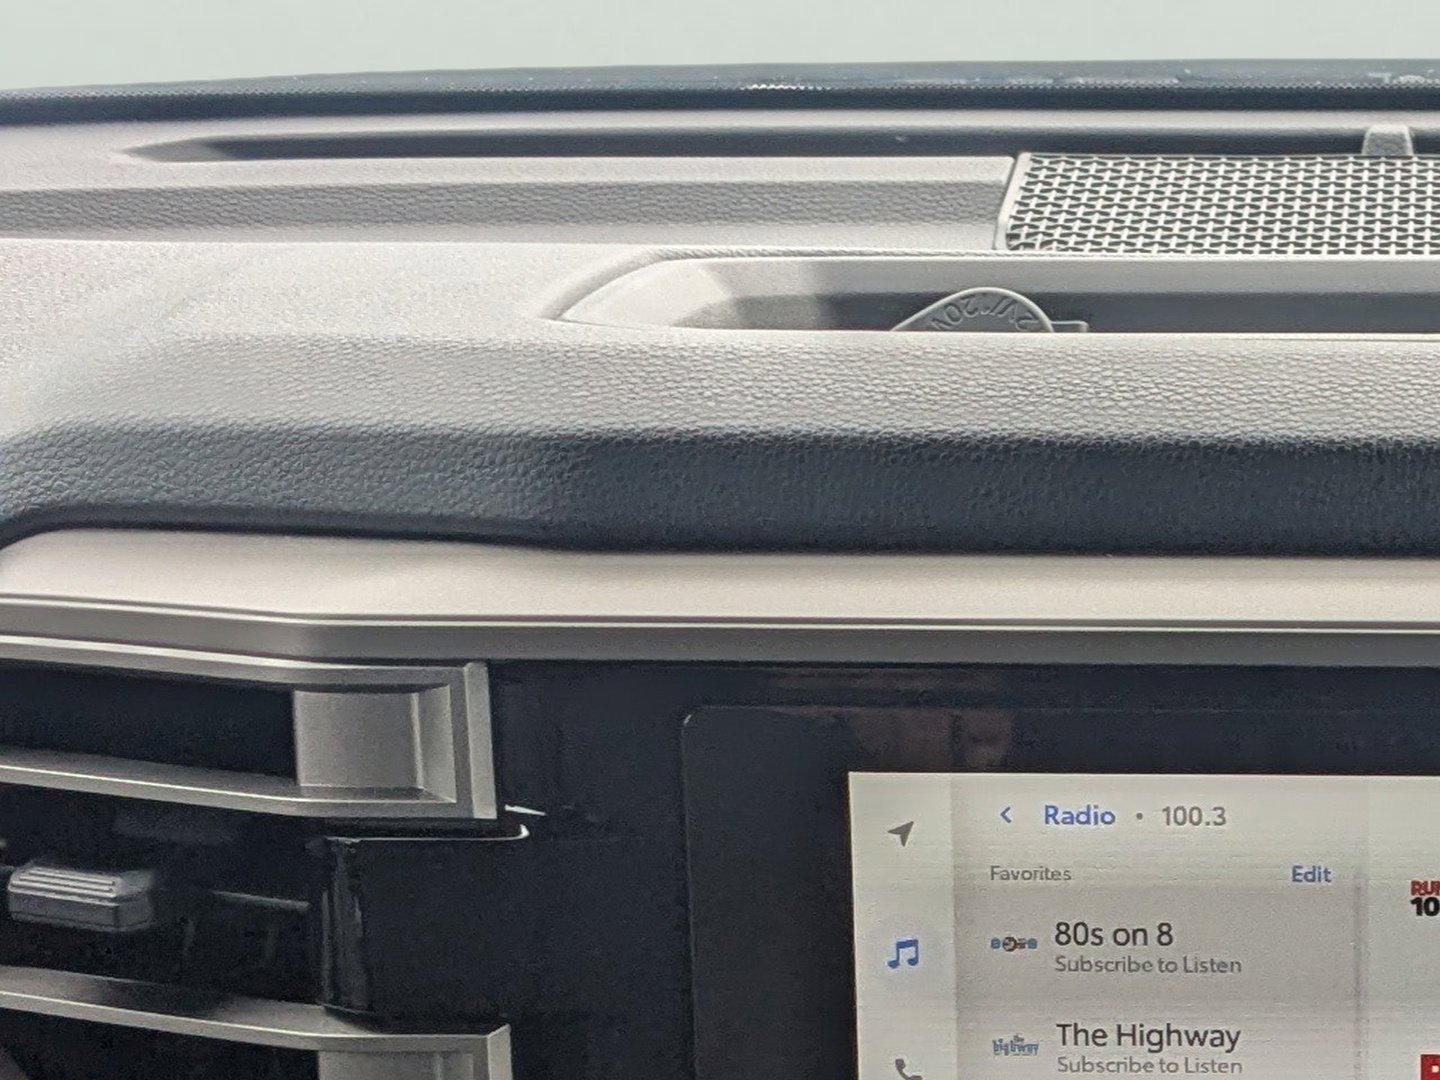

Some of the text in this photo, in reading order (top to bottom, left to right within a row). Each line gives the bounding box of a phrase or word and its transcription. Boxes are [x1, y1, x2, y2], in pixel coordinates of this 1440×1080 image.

[1045, 805, 1228, 827] Radio 100.3
[990, 865, 1072, 882] Favorites
[1291, 866, 1332, 883] Edit
[1055, 921, 1104, 947] 80s
[1112, 927, 1148, 947] on
[1156, 922, 1174, 947] 8
[1055, 956, 1241, 974] Subscribe to Listen
[1057, 1023, 1241, 1054] The Highway
[1057, 1056, 1243, 1074] Subscribe to Listen
